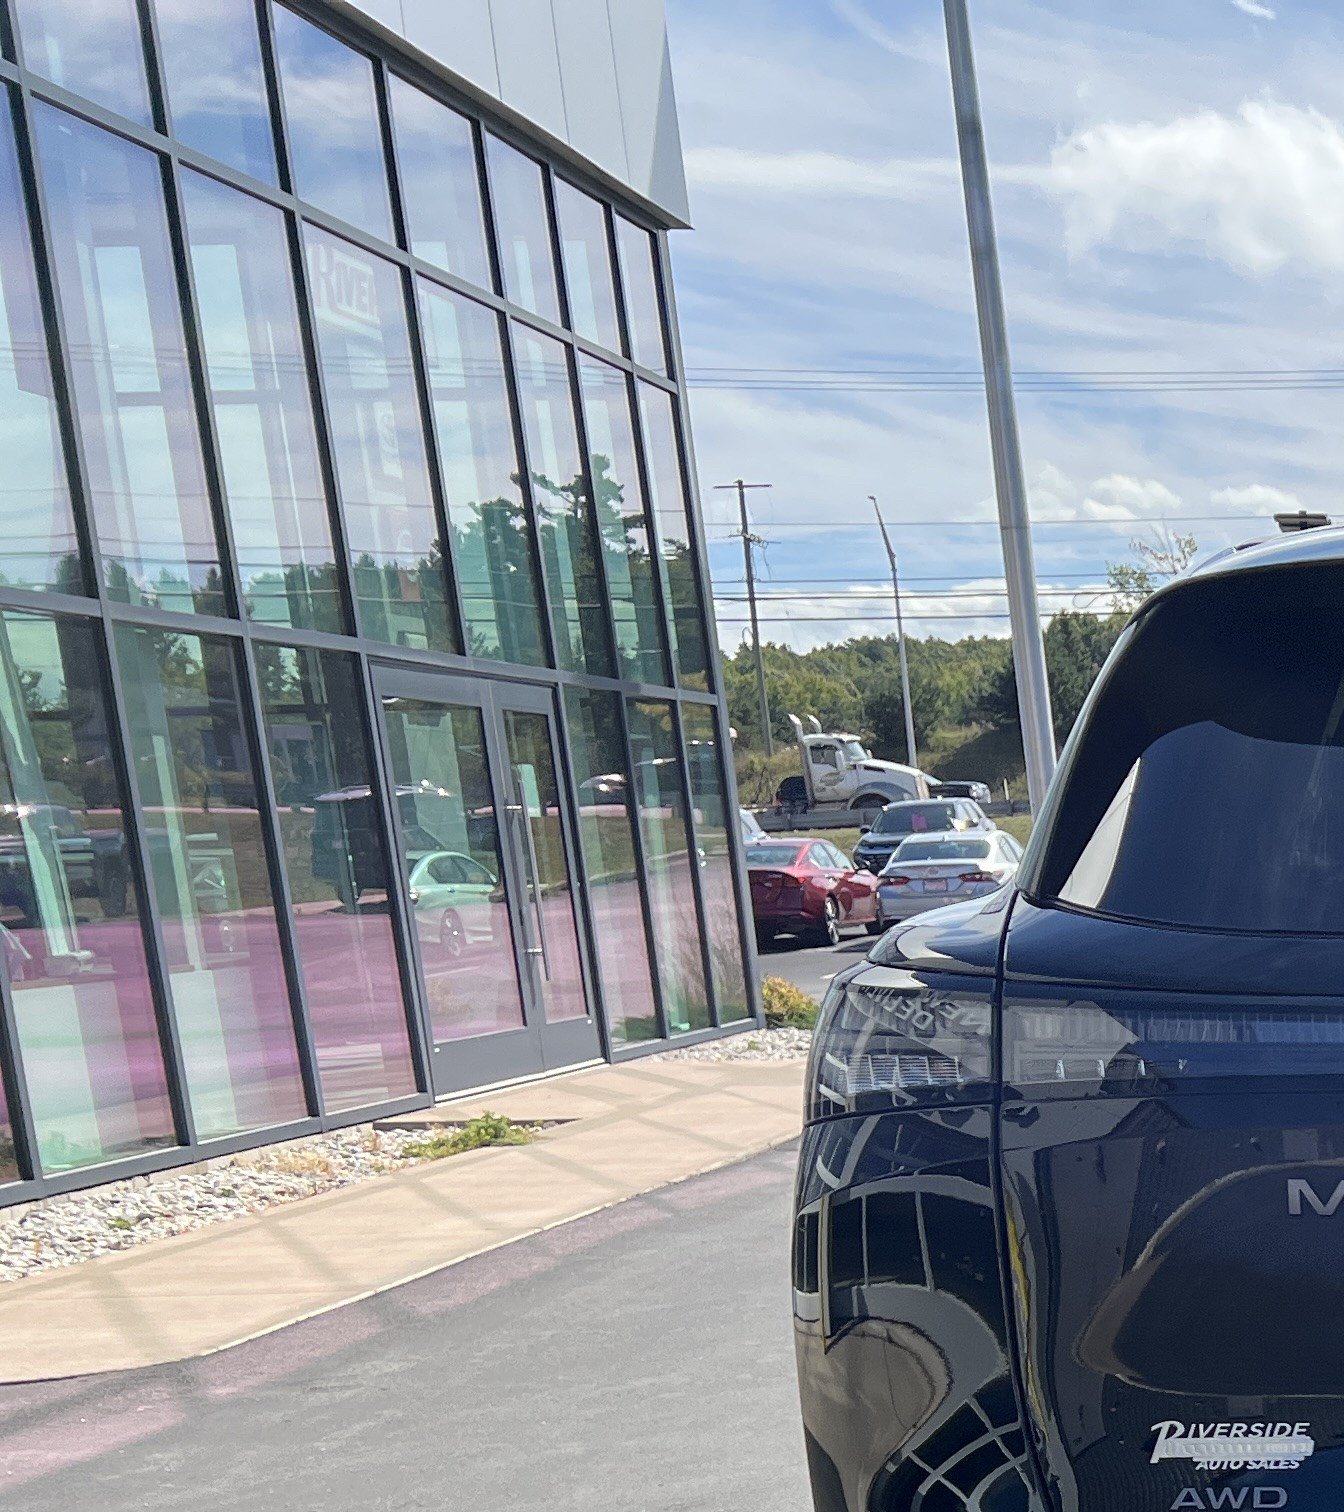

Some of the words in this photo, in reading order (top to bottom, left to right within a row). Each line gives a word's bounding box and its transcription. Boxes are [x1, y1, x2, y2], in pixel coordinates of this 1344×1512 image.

[1150, 1420, 1310, 1464] RIVERSIDE
[1195, 1459, 1244, 1471] AUTO
[1246, 1459, 1300, 1470] SALES
[1170, 1486, 1288, 1511] AWD
